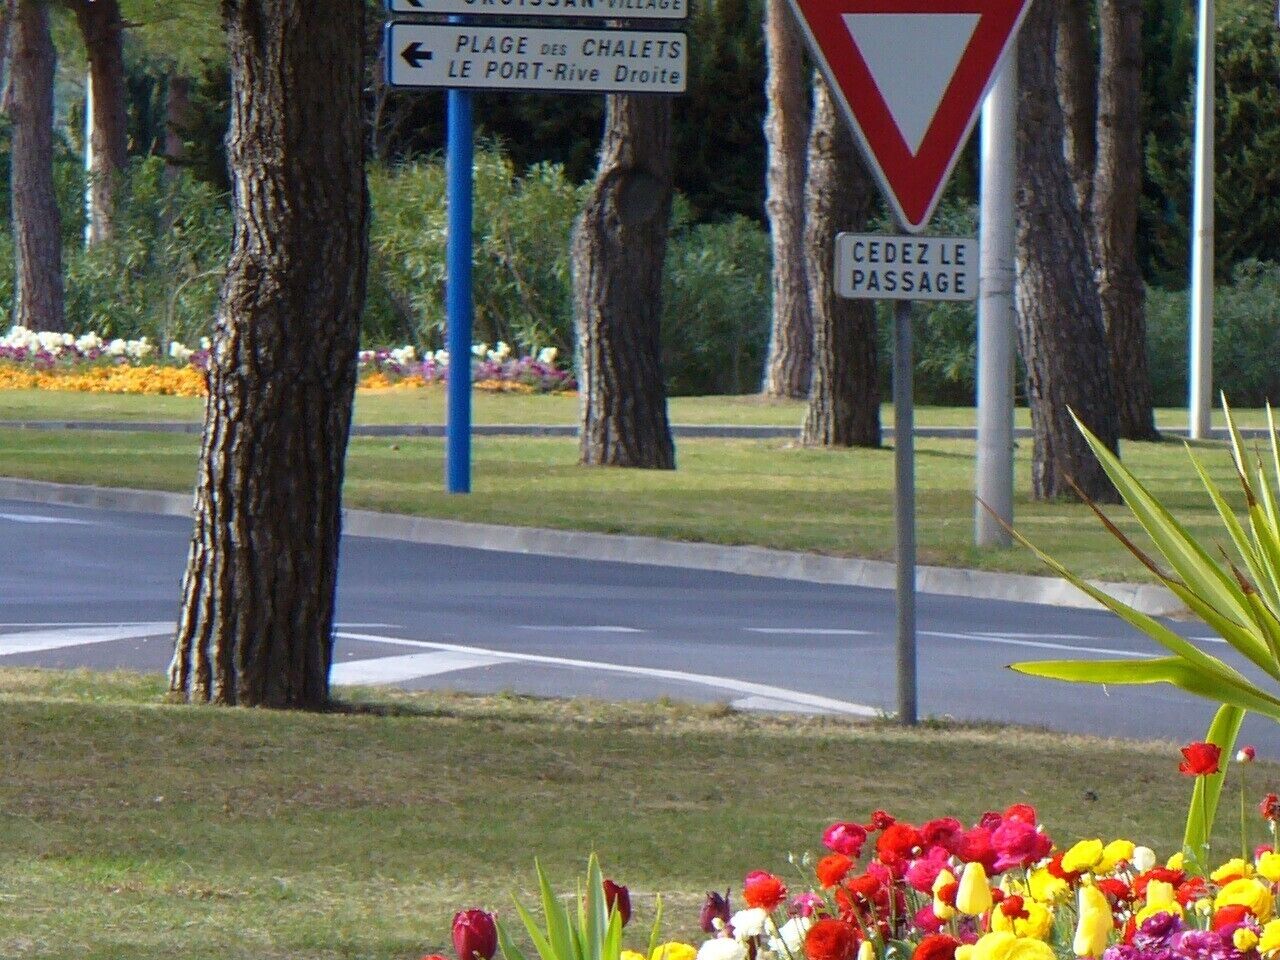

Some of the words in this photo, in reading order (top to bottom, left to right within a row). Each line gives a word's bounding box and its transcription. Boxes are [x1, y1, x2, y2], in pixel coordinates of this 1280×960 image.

[455, 35, 529, 54] PLAGE
[540, 43, 567, 56] DES
[581, 38, 682, 59] CHALETS
[448, 60, 472, 78] LE
[485, 61, 601, 82] PORT-Rive
[614, 64, 681, 84] Droite
[853, 241, 929, 265] CEDEZ
[940, 243, 966, 266] LE
[851, 269, 966, 294] PASSAGE
